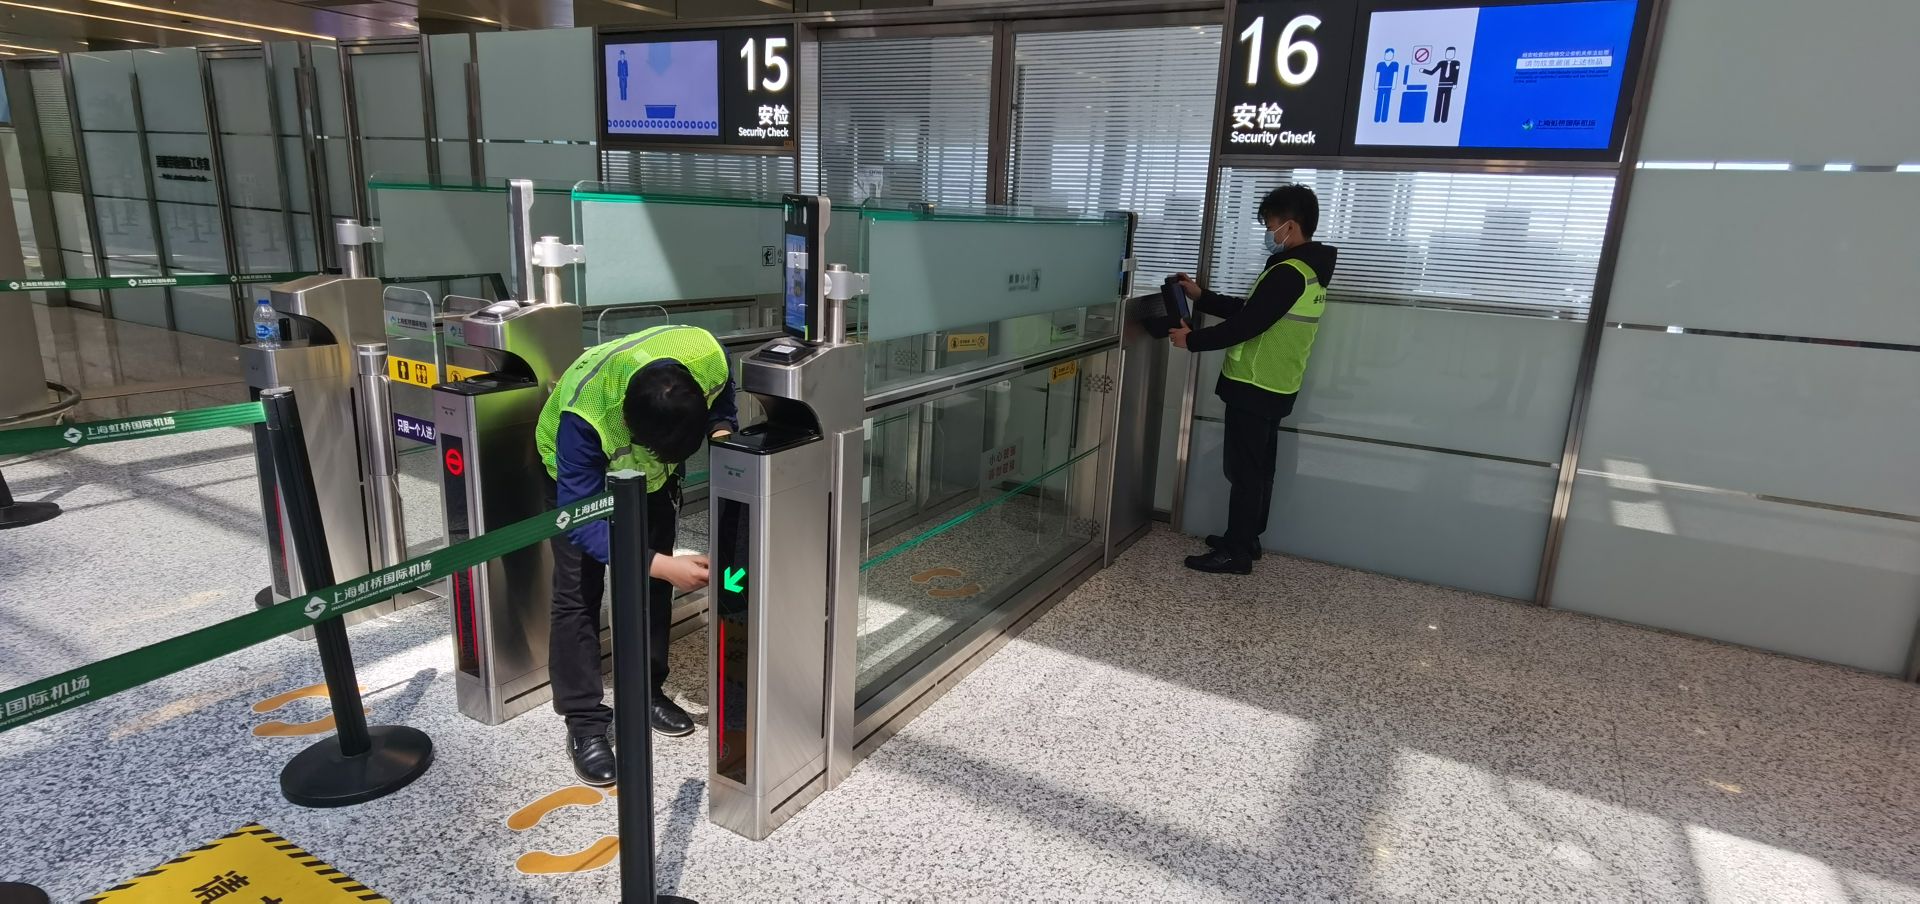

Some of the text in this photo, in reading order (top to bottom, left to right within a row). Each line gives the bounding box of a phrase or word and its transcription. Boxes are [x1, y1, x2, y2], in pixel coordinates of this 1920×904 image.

[740, 37, 789, 92] 15
[1240, 13, 1322, 87] 16
[738, 126, 789, 139] Security Check
[757, 104, 790, 126] 安检
[1231, 102, 1284, 130] 安检
[1230, 131, 1316, 147] Security Check
[331, 559, 432, 605] 上海虹桥国际机场
[0, 674, 91, 719] 国际机场
